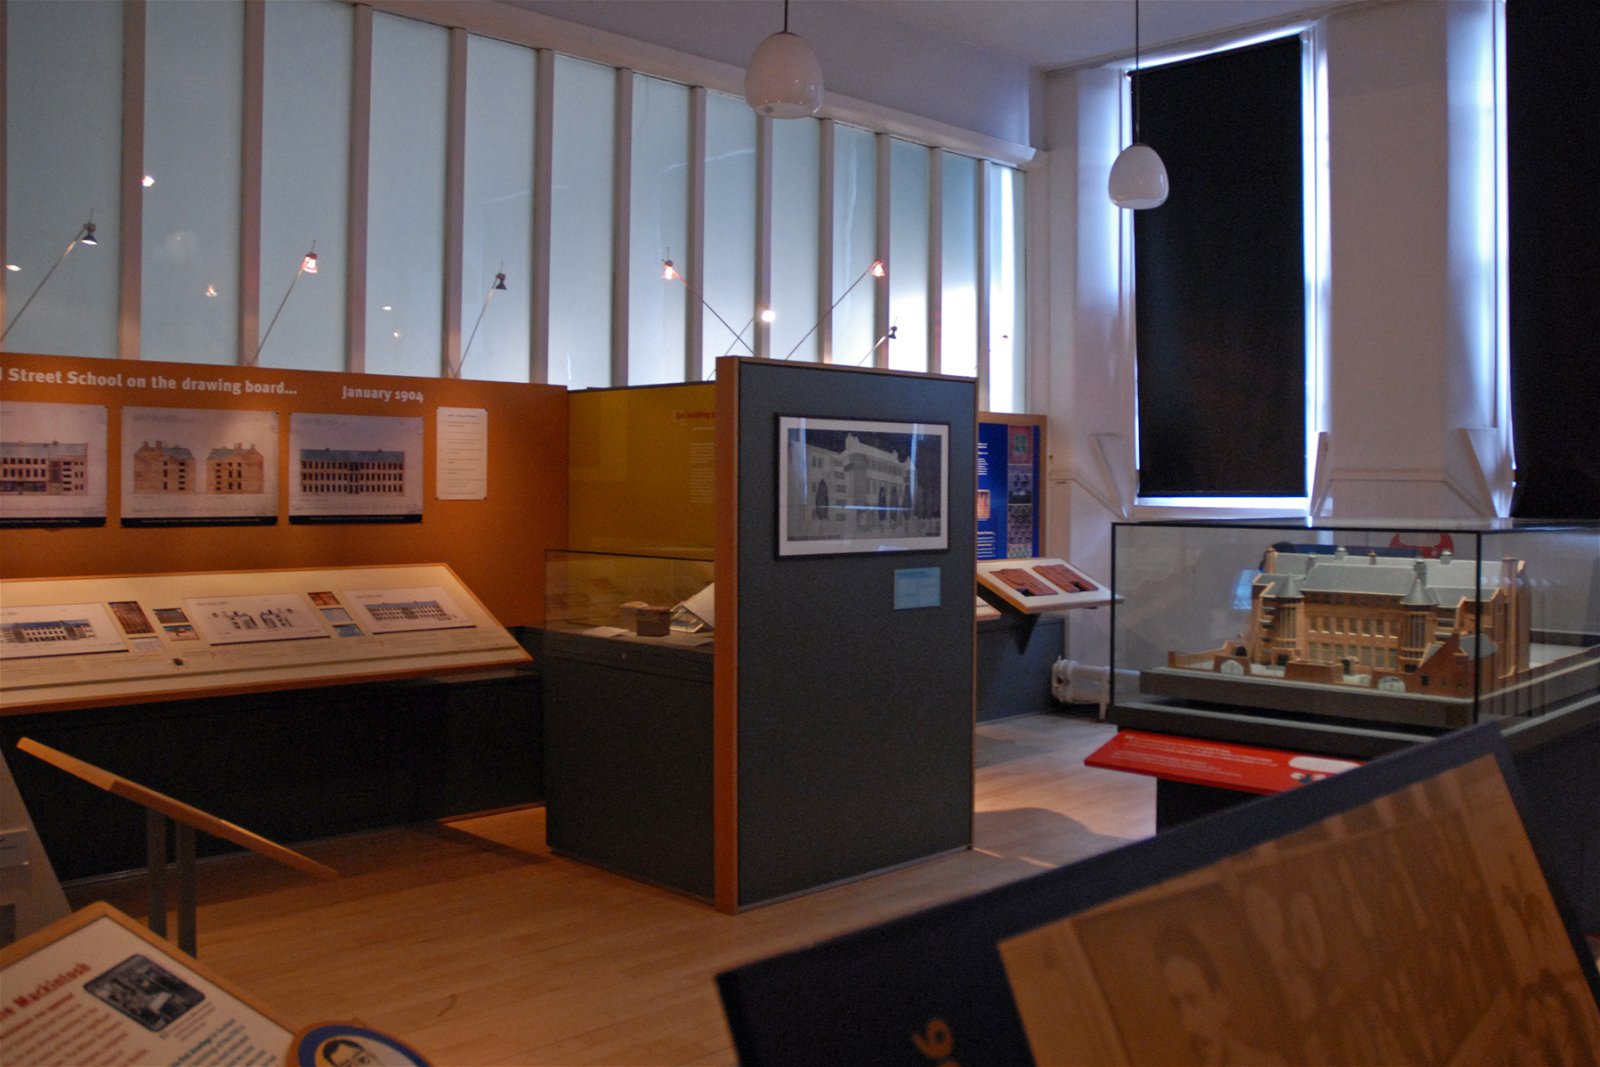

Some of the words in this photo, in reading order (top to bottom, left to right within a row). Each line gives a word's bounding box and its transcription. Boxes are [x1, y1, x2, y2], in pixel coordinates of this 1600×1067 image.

[8, 367, 62, 384] Street
[67, 371, 122, 387] School
[127, 377, 146, 388] on
[151, 376, 176, 389] the
[182, 378, 241, 395] drawing
[245, 380, 297, 395] board...
[341, 385, 392, 402] January
[394, 390, 424, 403] 1904
[13, 962, 91, 1009] Mackintosh
